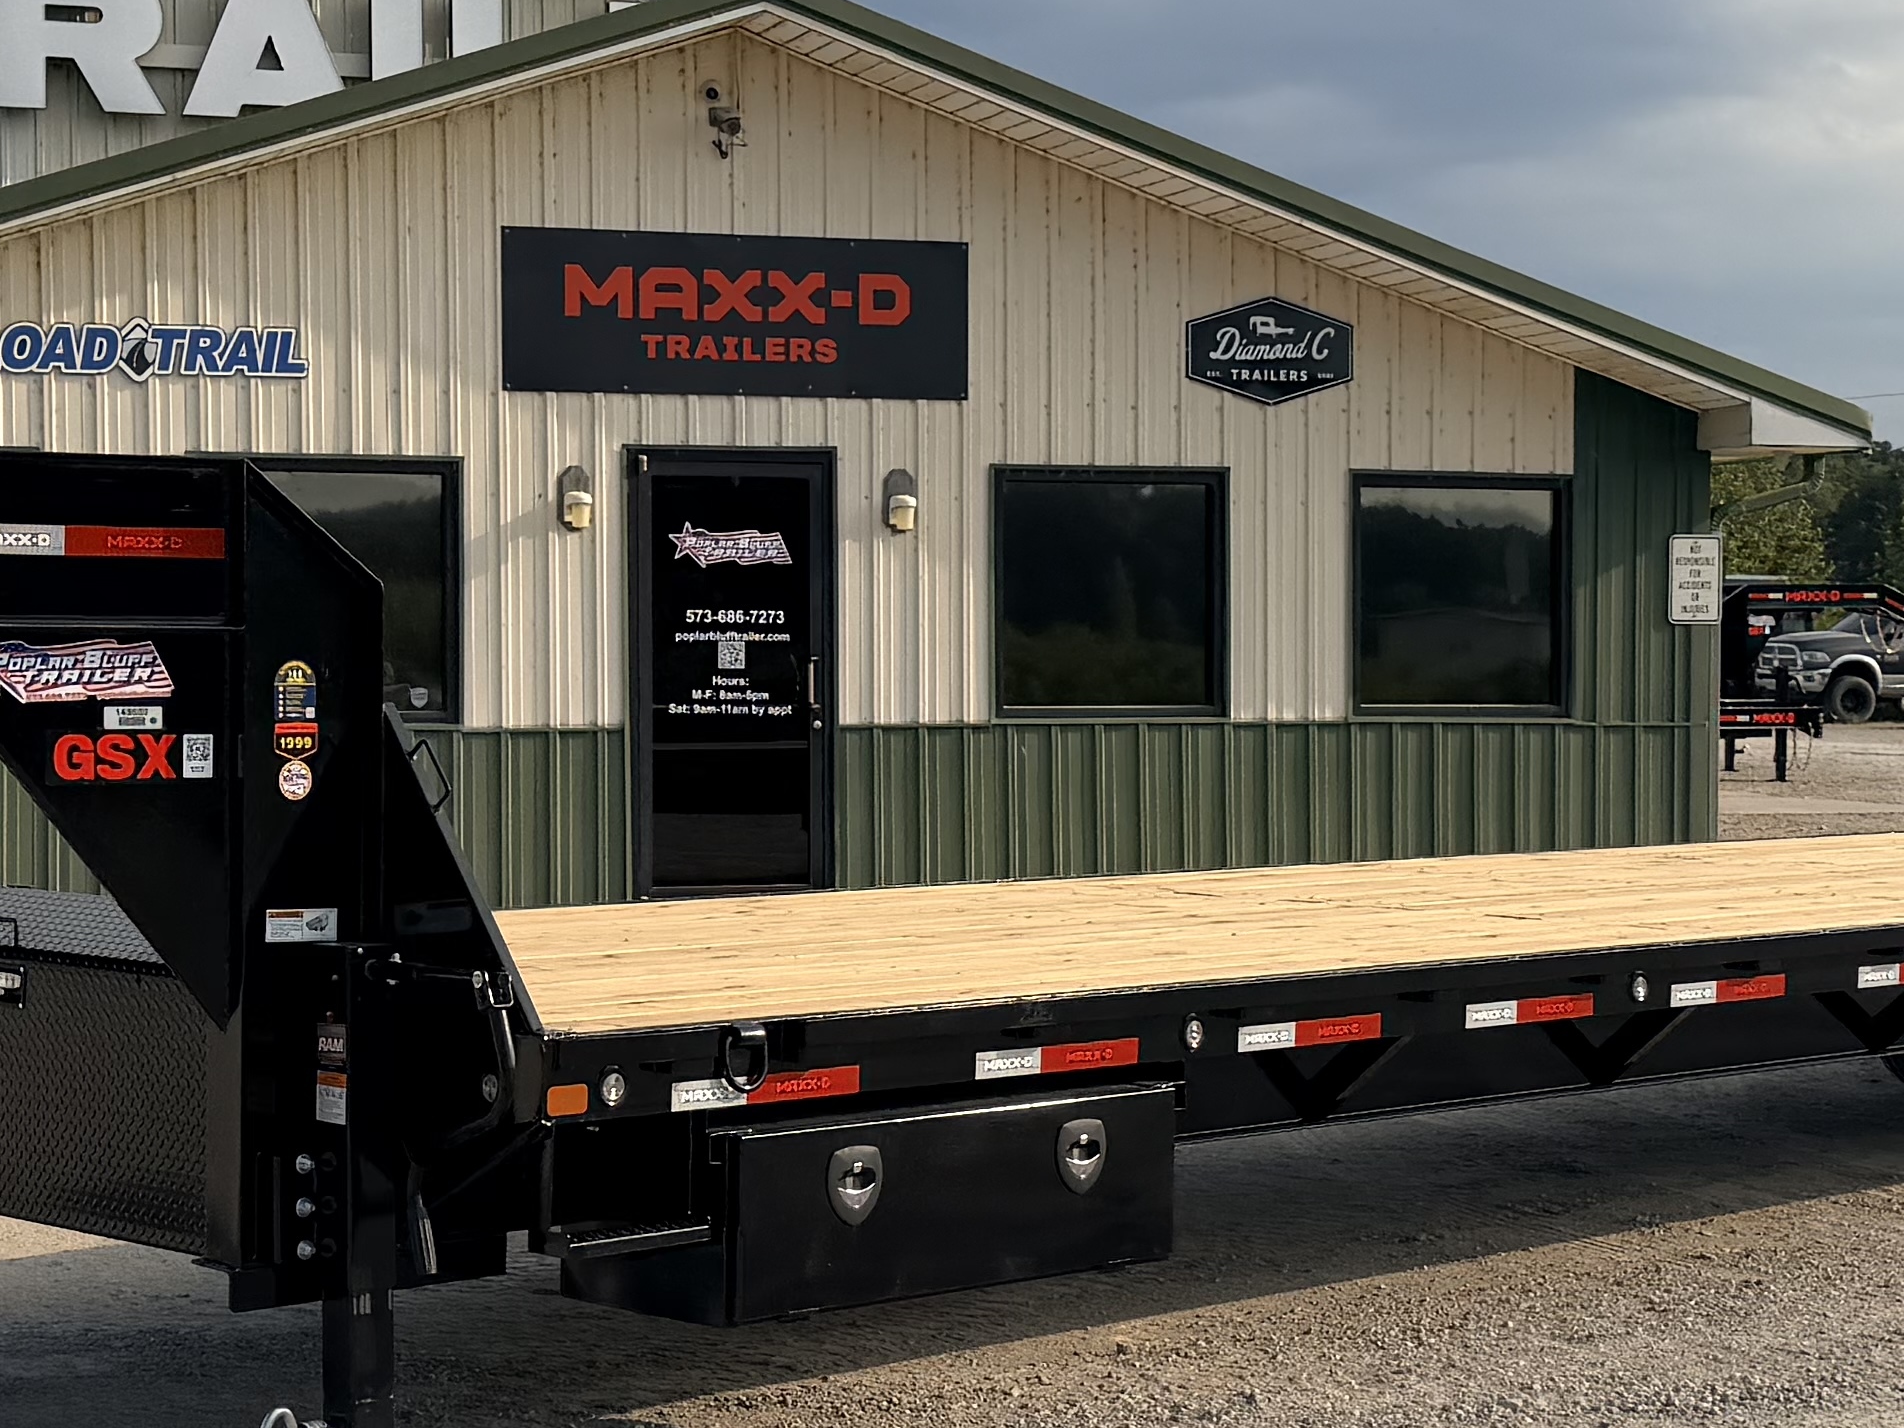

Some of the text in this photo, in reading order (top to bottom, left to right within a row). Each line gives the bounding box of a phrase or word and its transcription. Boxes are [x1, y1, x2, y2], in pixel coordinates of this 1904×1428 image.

[563, 263, 911, 326] MAXX-D
[148, 326, 309, 376] TRAIL
[640, 334, 838, 364] TRAILERS
[1209, 326, 1335, 361] Diamond C
[1230, 368, 1308, 382] TRAILERS
[685, 609, 785, 624] 573-686-7273
[82, 650, 157, 668] BLUFF
[22, 667, 154, 685] TRAILER
[712, 675, 750, 686] Hours:
[53, 734, 177, 780] GSX
[318, 1037, 344, 1052] RAM
